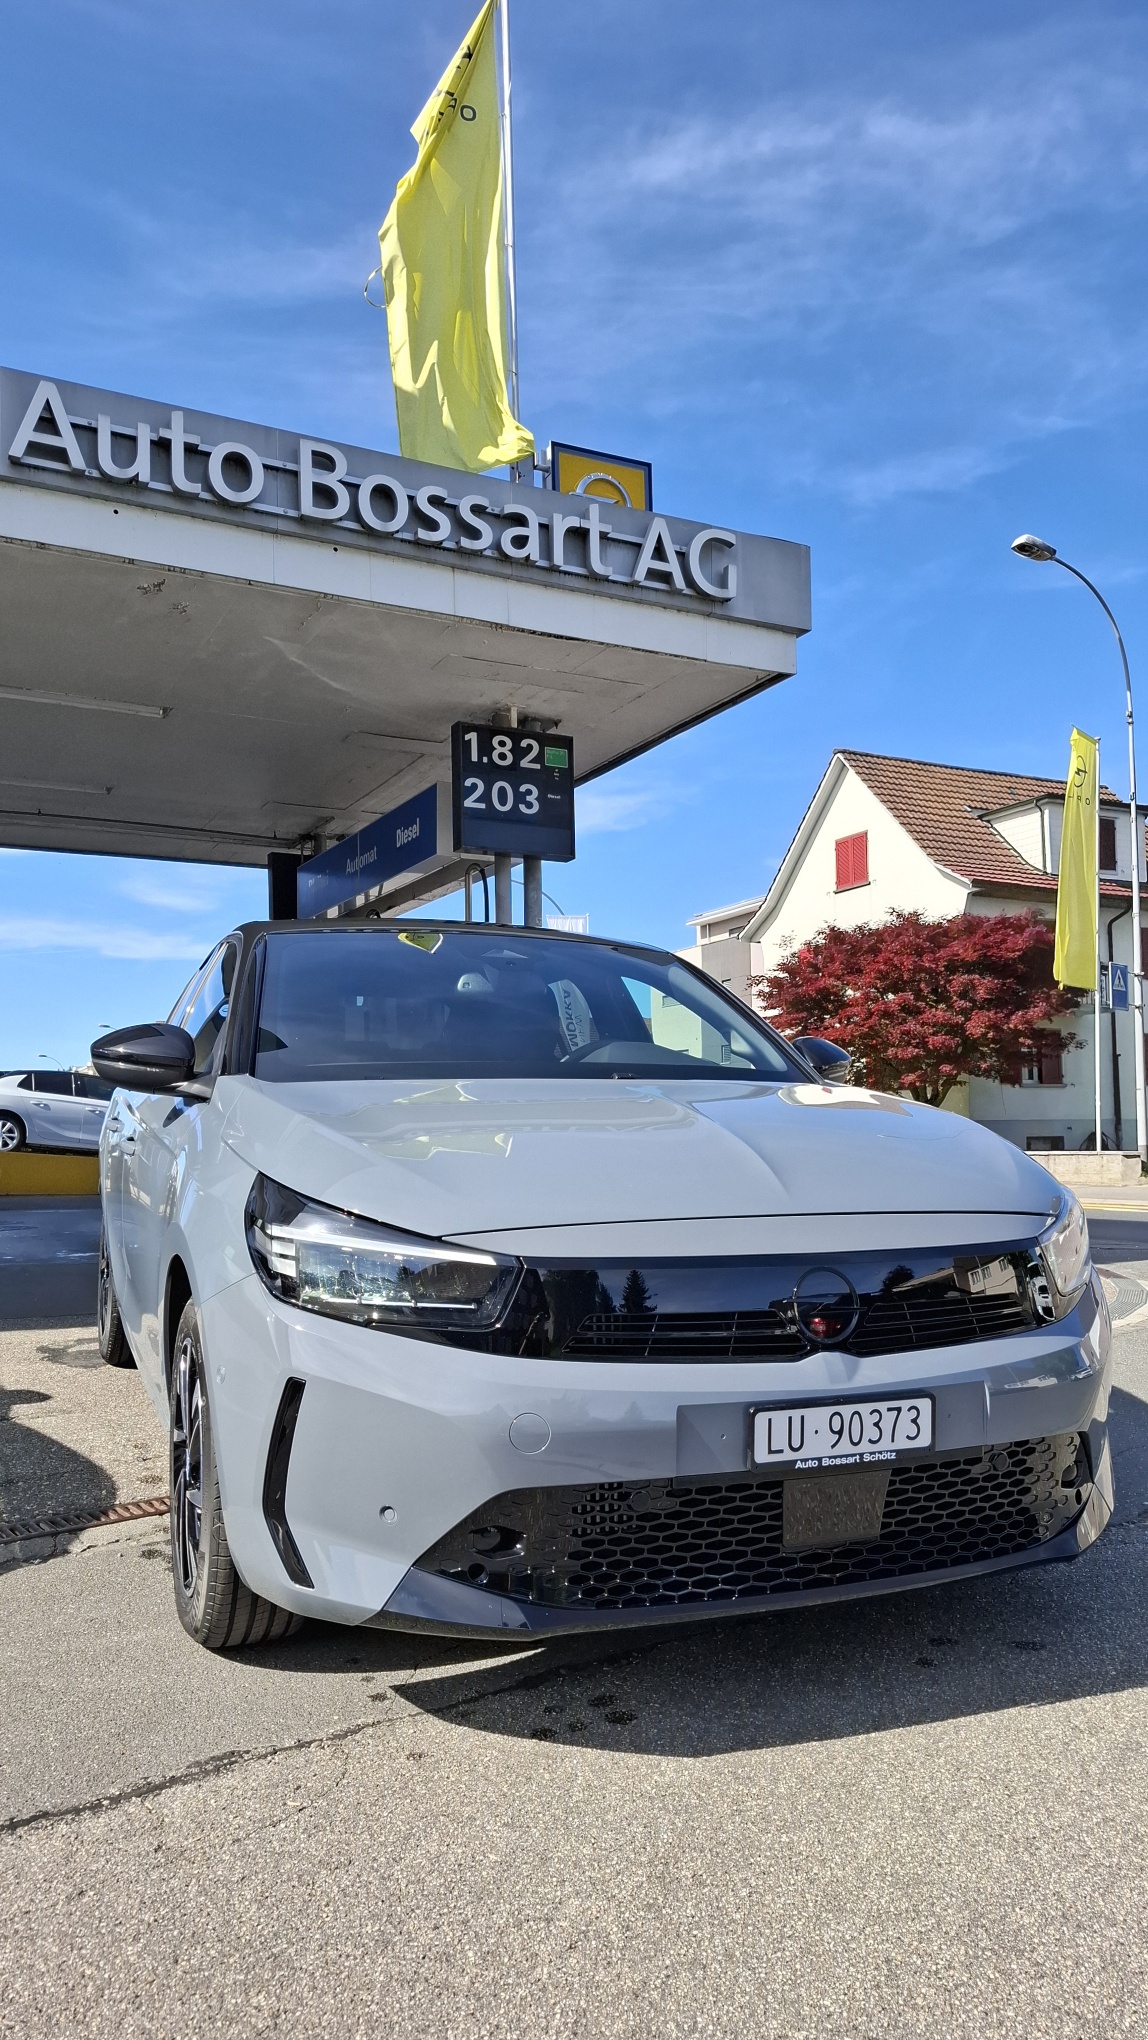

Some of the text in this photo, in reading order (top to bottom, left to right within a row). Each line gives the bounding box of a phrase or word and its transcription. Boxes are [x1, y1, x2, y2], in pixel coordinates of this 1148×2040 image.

[8, 380, 737, 600] Auto Bossart AG
[464, 731, 541, 769] 1.82
[463, 777, 540, 815] 203
[396, 817, 420, 848] Diesel
[346, 845, 378, 876] Automat
[794, 1451, 896, 1469] Auto Bossart Schötz
